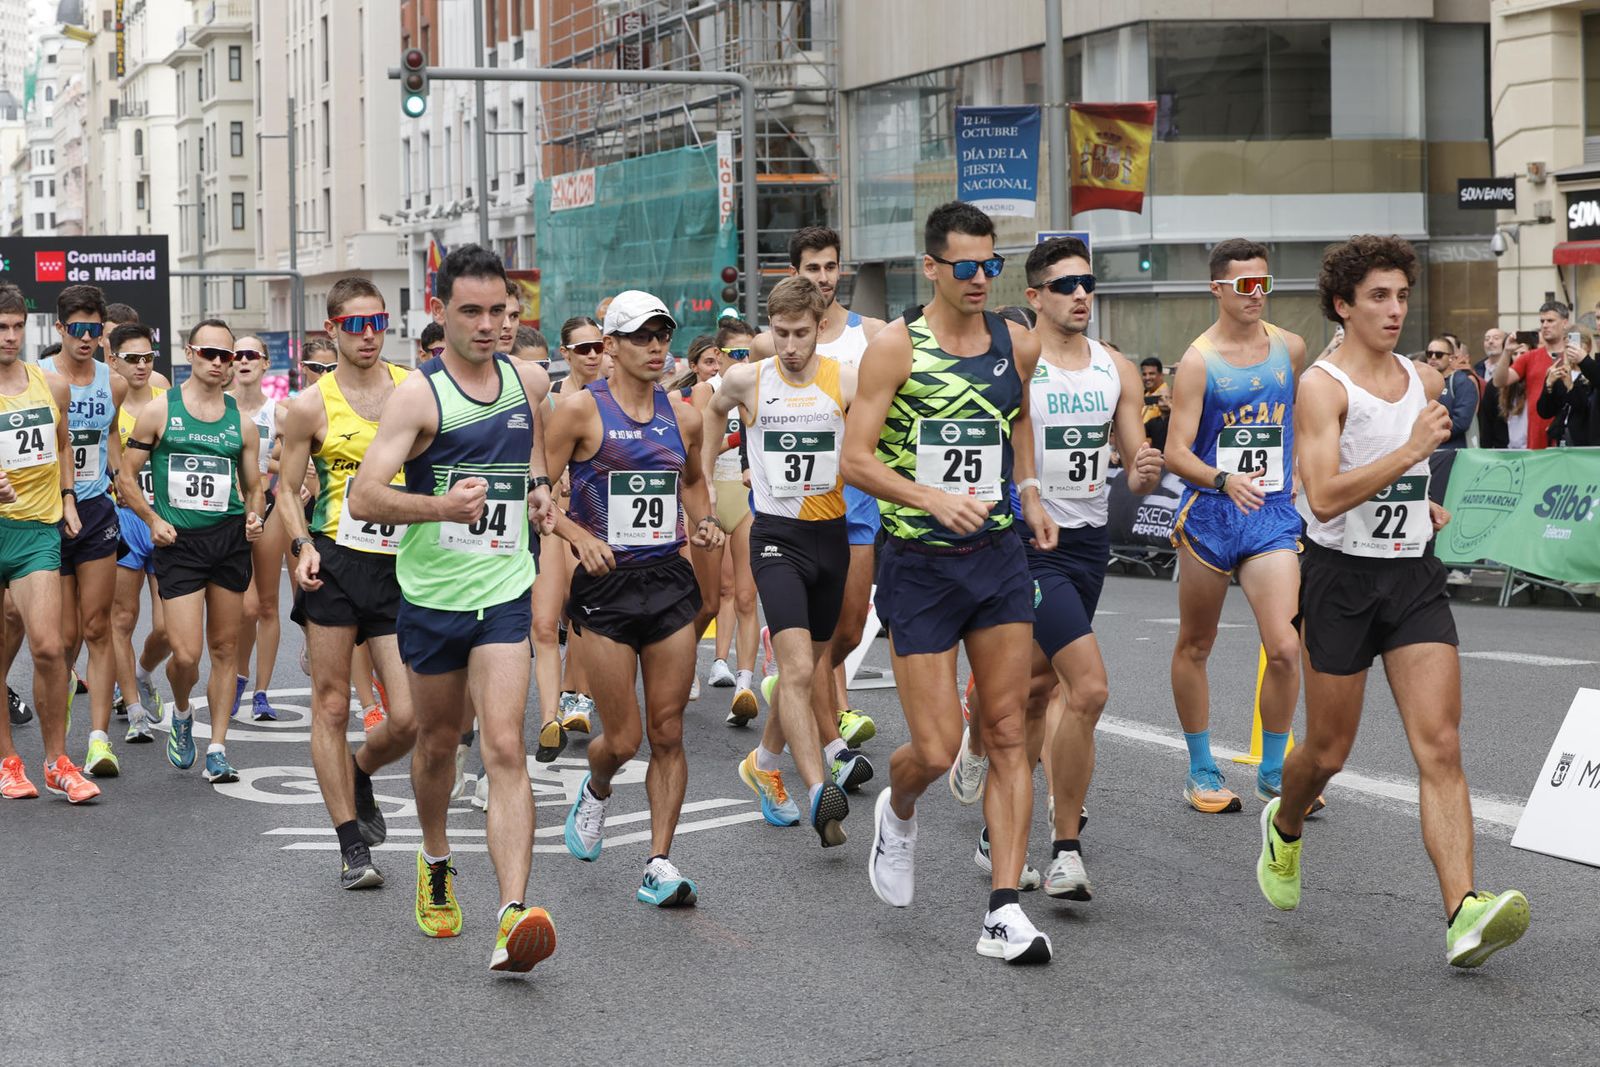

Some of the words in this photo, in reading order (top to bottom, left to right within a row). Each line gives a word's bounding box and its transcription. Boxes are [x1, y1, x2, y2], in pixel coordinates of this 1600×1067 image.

[963, 116, 972, 126] 12
[961, 127, 1018, 138] OCTUBRE
[963, 147, 985, 161] DÍA
[988, 148, 1007, 159] DE
[1009, 147, 1028, 159] LA
[963, 163, 1005, 177] FIESTA
[963, 178, 1032, 192] NACIONAL
[1460, 187, 1514, 201] SOUVENIRS
[983, 204, 1014, 212] MADRID
[67, 250, 156, 264] Comunidad
[68, 268, 90, 281] de
[95, 266, 156, 281] Madrid
[68, 398, 105, 418] erja
[1047, 391, 1109, 414] BRASIL
[1222, 402, 1285, 427] UCAM
[16, 428, 44, 454] 24
[784, 454, 815, 482] 37
[943, 448, 982, 483] 25
[1068, 451, 1099, 482] 31
[1237, 449, 1268, 477] 43
[186, 474, 214, 498] 36
[1462, 494, 1486, 504] MADRID
[1486, 494, 1517, 507] MARCHA
[1534, 484, 1598, 522] Silbö
[632, 497, 663, 529] 29
[1136, 506, 1173, 527] SKEC
[1372, 504, 1408, 539] 22
